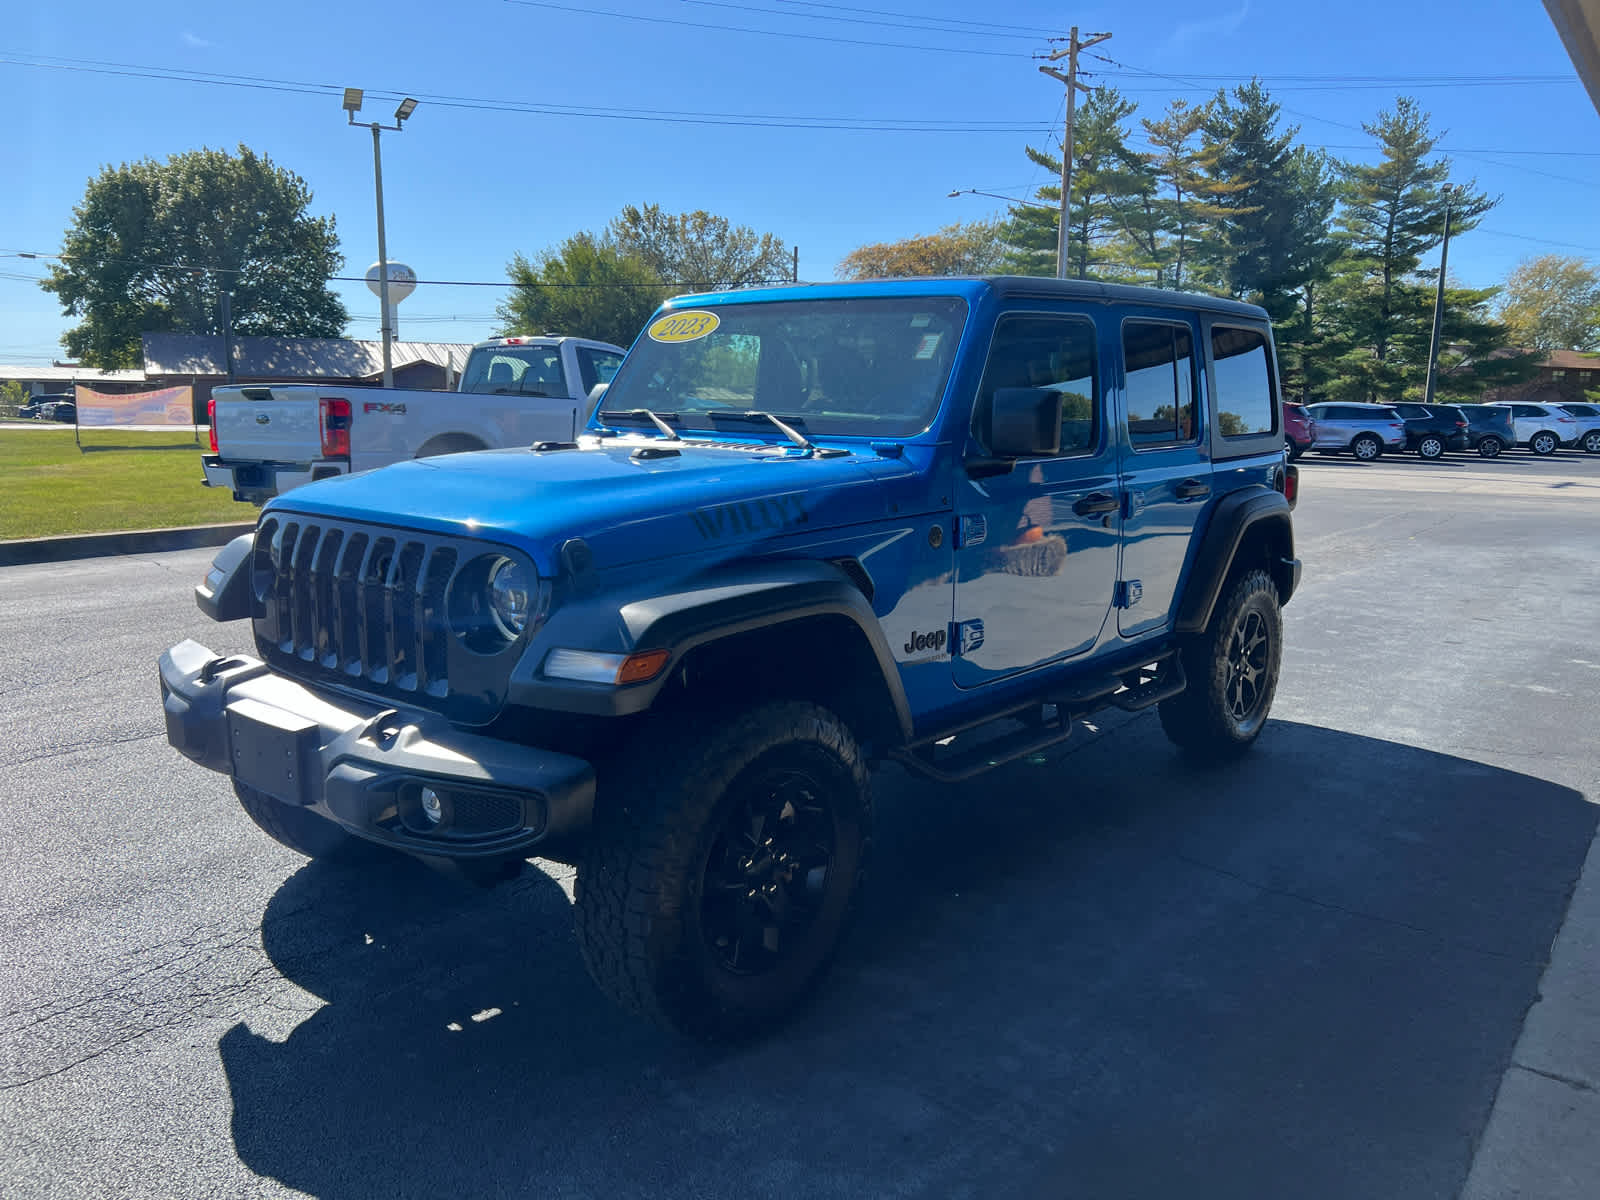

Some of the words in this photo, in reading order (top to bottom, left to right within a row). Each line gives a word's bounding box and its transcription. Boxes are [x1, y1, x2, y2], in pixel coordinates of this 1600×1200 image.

[657, 317, 711, 337] 2023
[363, 402, 407, 416] FX4
[904, 629, 946, 654] Jeep
